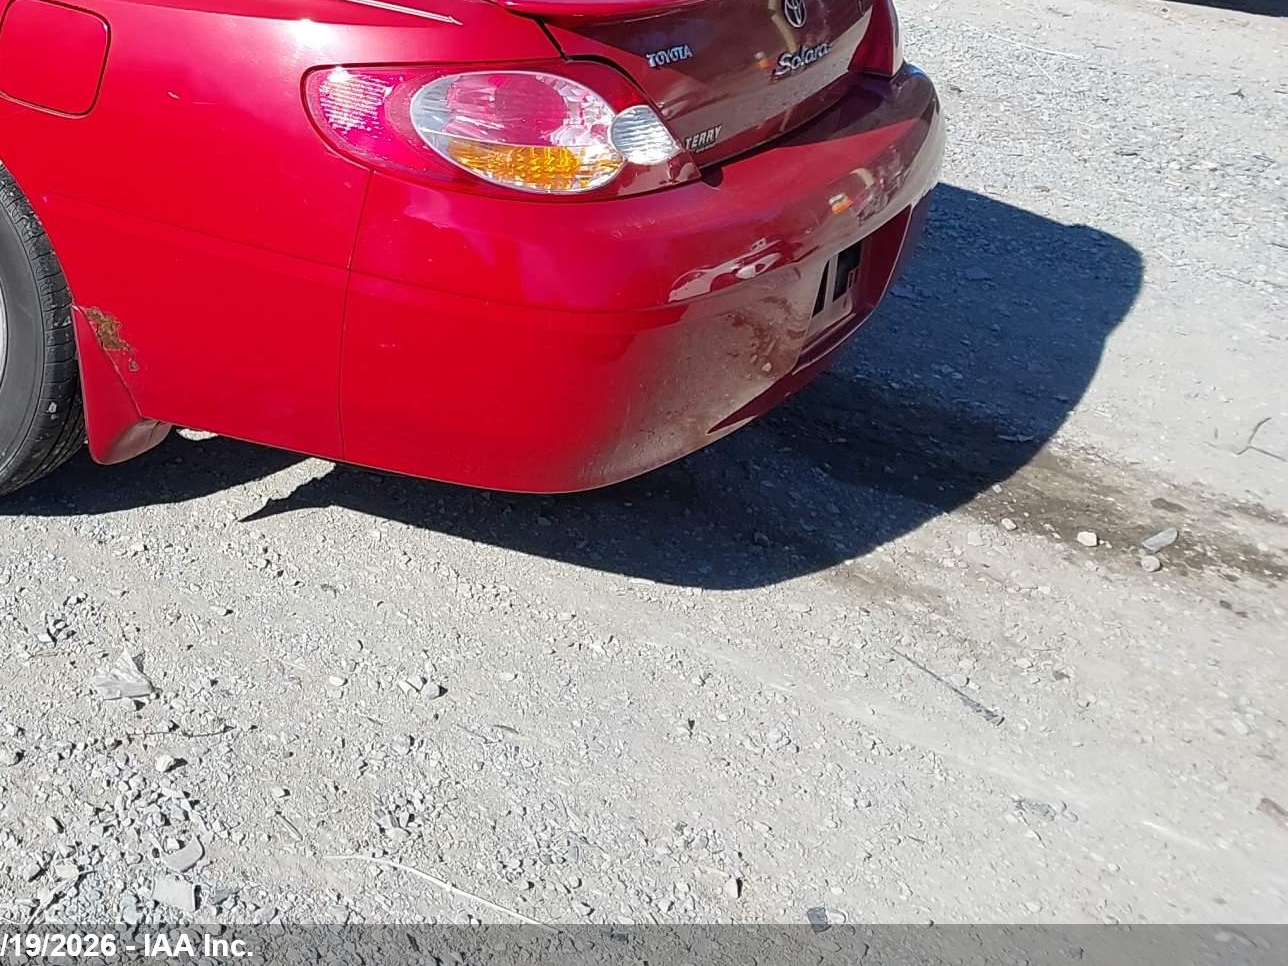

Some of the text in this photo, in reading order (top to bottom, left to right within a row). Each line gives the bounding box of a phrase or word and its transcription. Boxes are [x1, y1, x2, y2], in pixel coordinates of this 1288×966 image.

[646, 44, 694, 68] TOYOTA
[772, 40, 832, 76] Solara
[684, 125, 722, 151] TERRY
